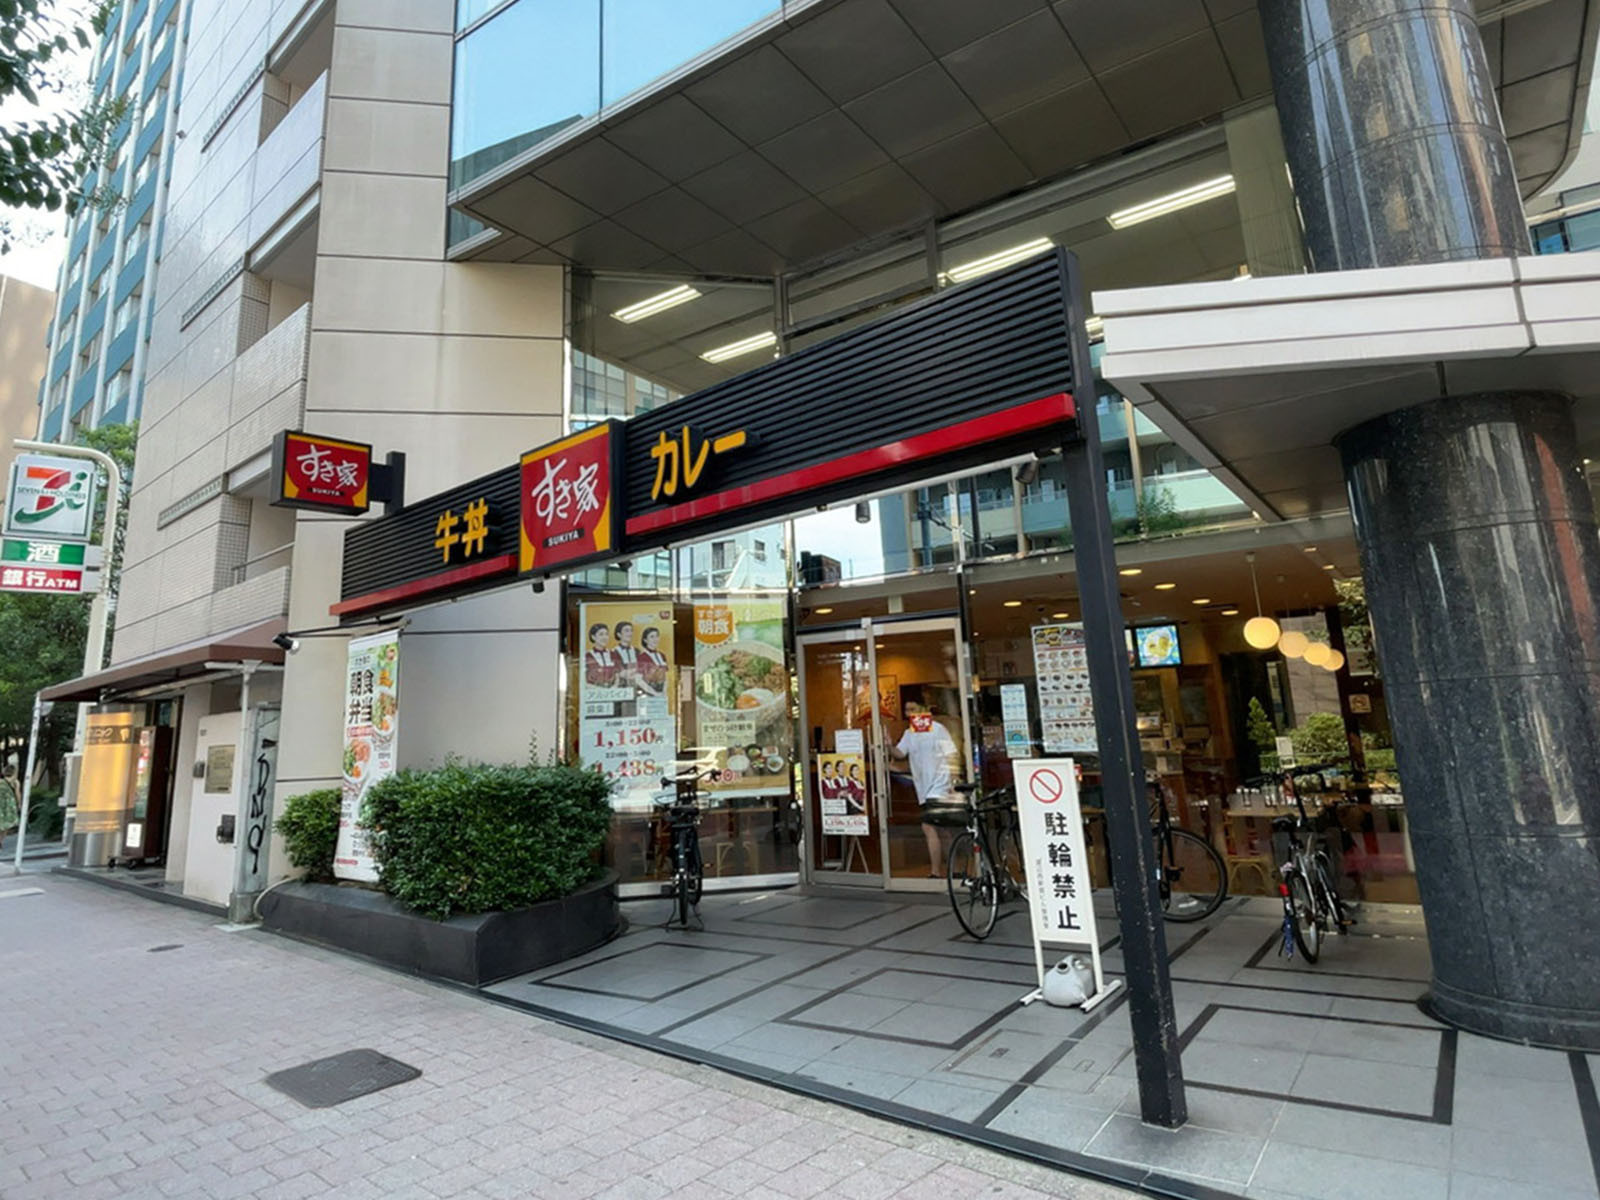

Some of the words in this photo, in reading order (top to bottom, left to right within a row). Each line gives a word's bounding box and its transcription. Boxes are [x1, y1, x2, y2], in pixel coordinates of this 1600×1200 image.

[296, 444, 358, 489] すき家
[651, 425, 746, 500] カレー
[532, 459, 599, 527] すき家
[26, 542, 62, 562] 酒
[435, 498, 488, 563] 牛丼
[548, 530, 579, 547] SUKIYA
[2, 569, 78, 589] 銀行ATM
[1044, 812, 1081, 930] 駐輪禁止
